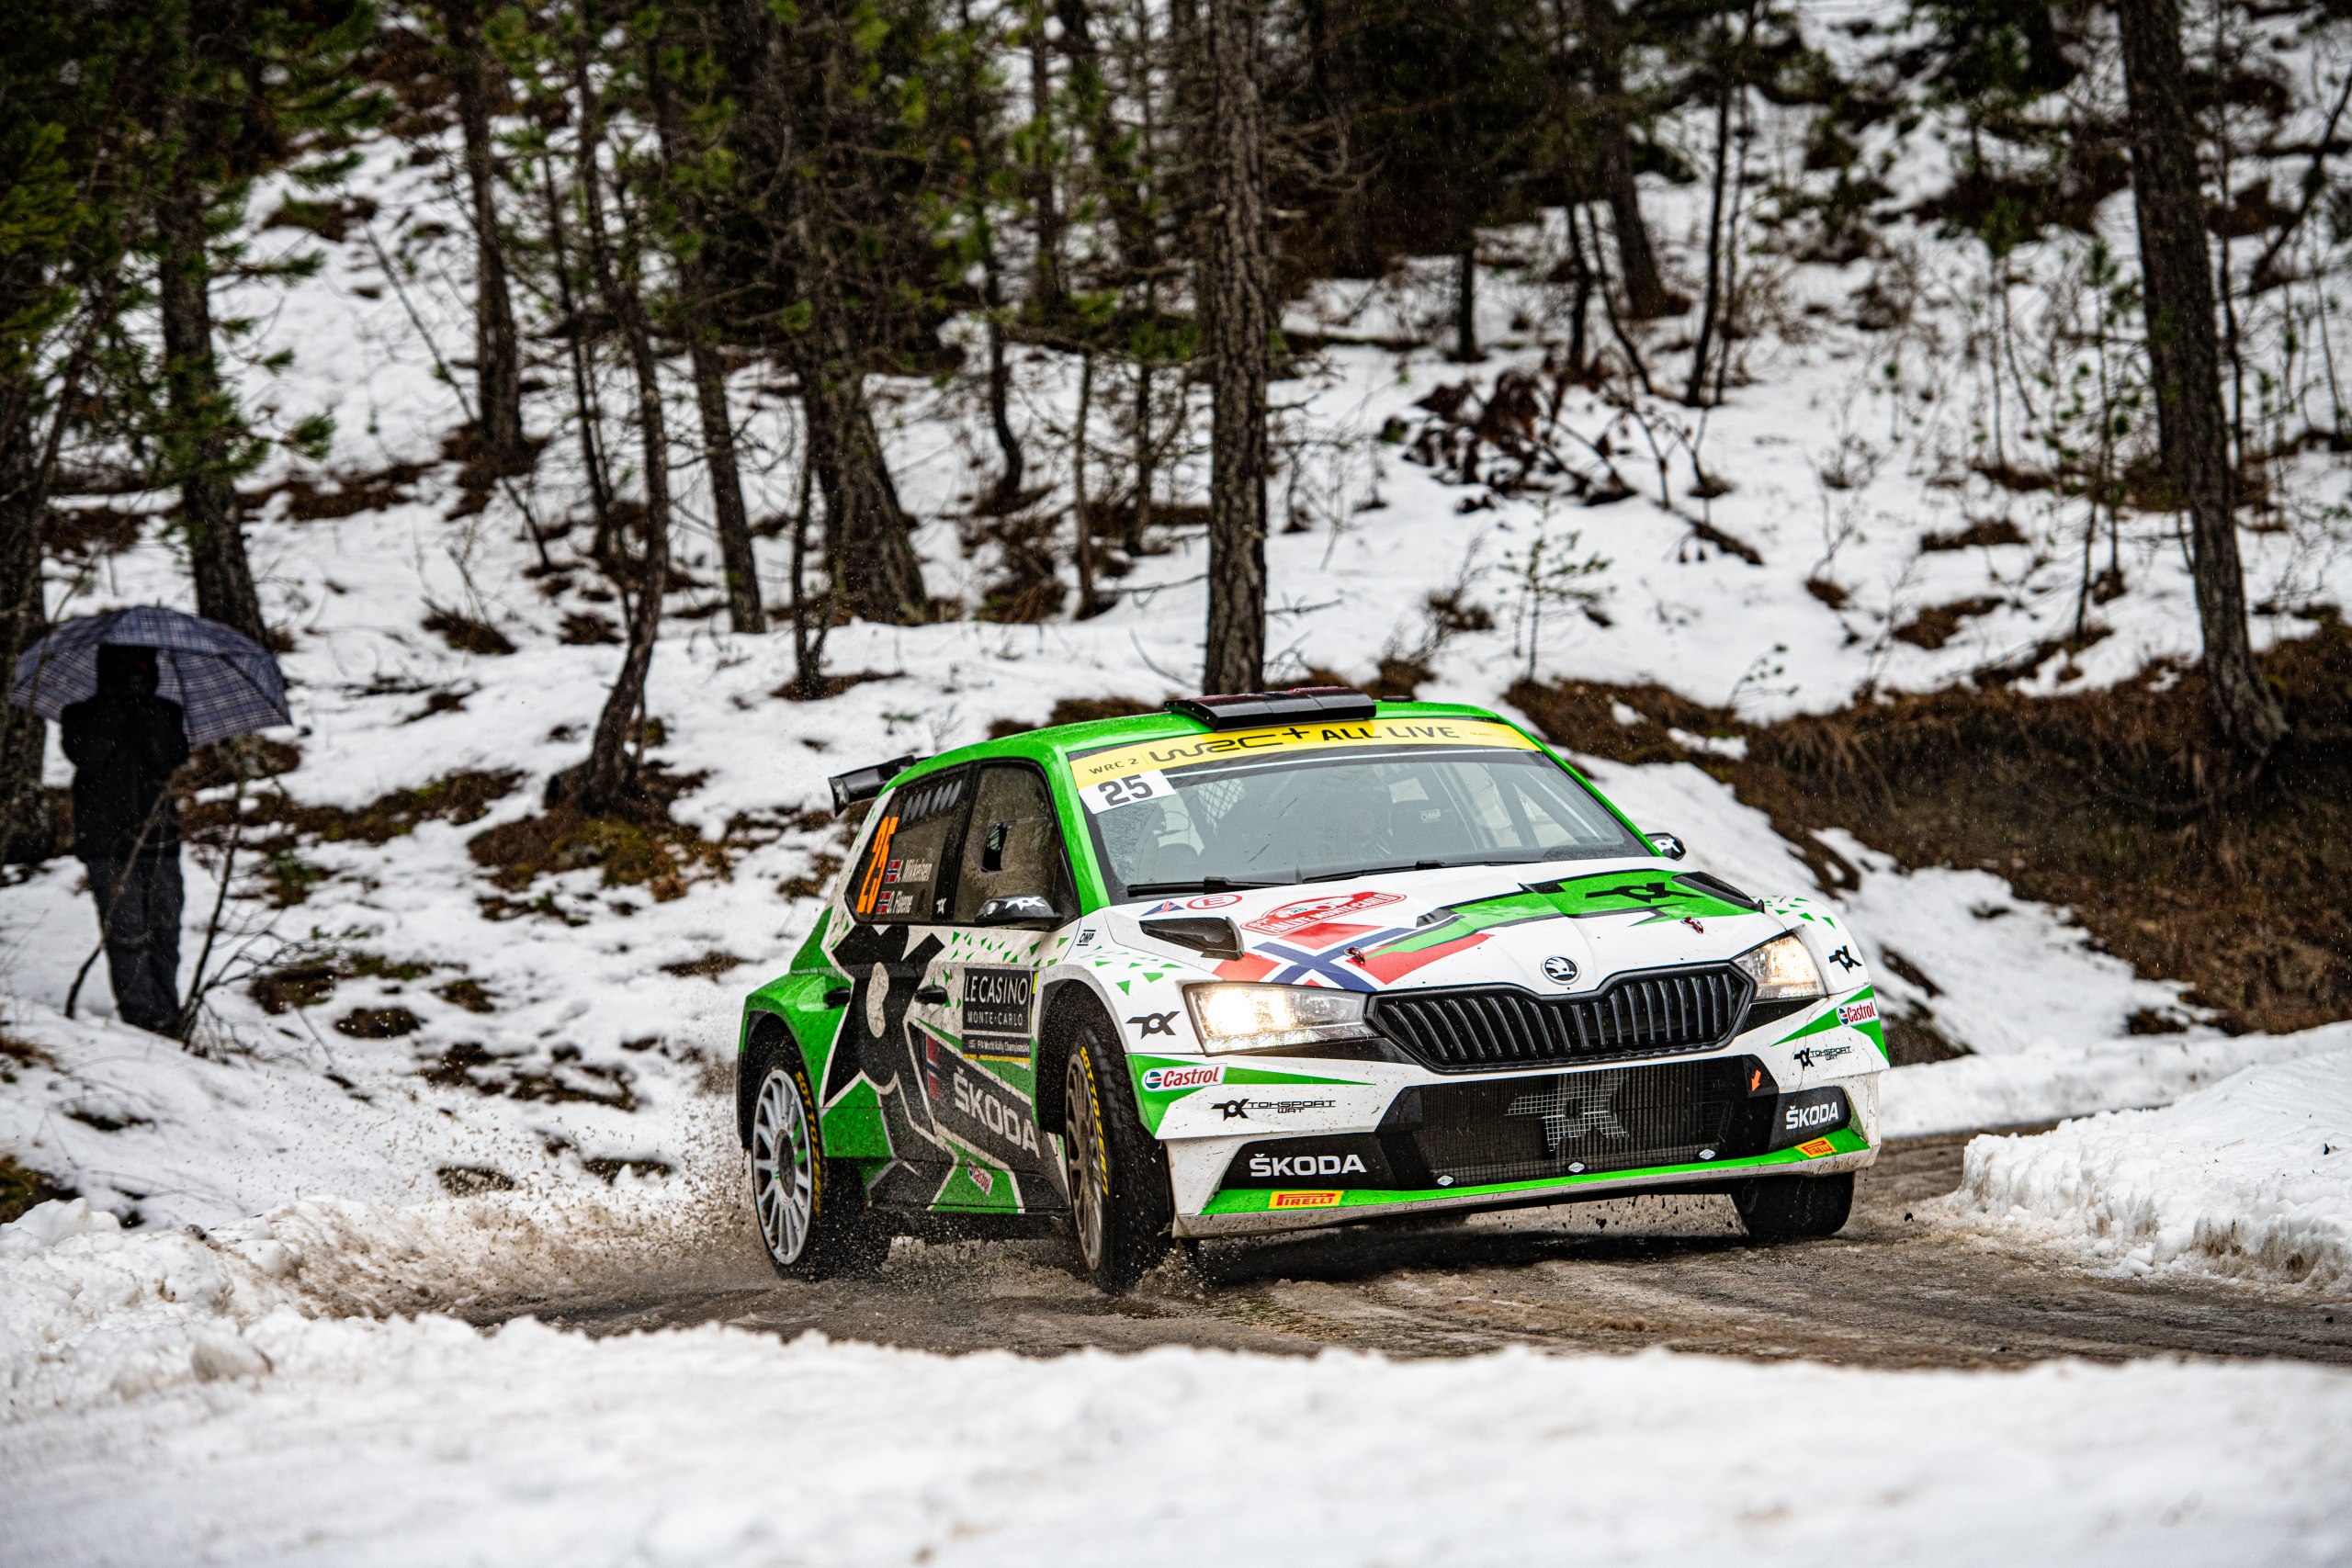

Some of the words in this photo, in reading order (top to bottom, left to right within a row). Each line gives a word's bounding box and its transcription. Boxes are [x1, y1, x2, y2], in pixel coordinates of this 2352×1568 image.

[1321, 728, 1382, 741] ALL
[1385, 727, 1460, 739] LIVE
[1089, 761, 1125, 774] WRC
[1130, 758, 1139, 766] 2
[1098, 774, 1153, 807] 25
[1420, 811, 1442, 821] OMP
[856, 816, 899, 915] 25
[1262, 915, 1312, 933] RALLYE
[1079, 932, 1095, 944] OMP
[965, 976, 978, 1002] LE
[978, 976, 1028, 1006] CASINO
[1848, 1001, 1876, 1023] Castrol
[1810, 1045, 1851, 1057] TOKSPORT
[1163, 1066, 1220, 1088] Castrol
[954, 1066, 1040, 1158] ŠKODA
[1248, 1100, 1337, 1109] TOKSPORT
[1786, 1102, 1839, 1130] ŠKODA
[1802, 1139, 1834, 1156] PIRELLI
[1250, 1153, 1367, 1178] ŠKODA
[1276, 1192, 1336, 1206] PIRELLI
